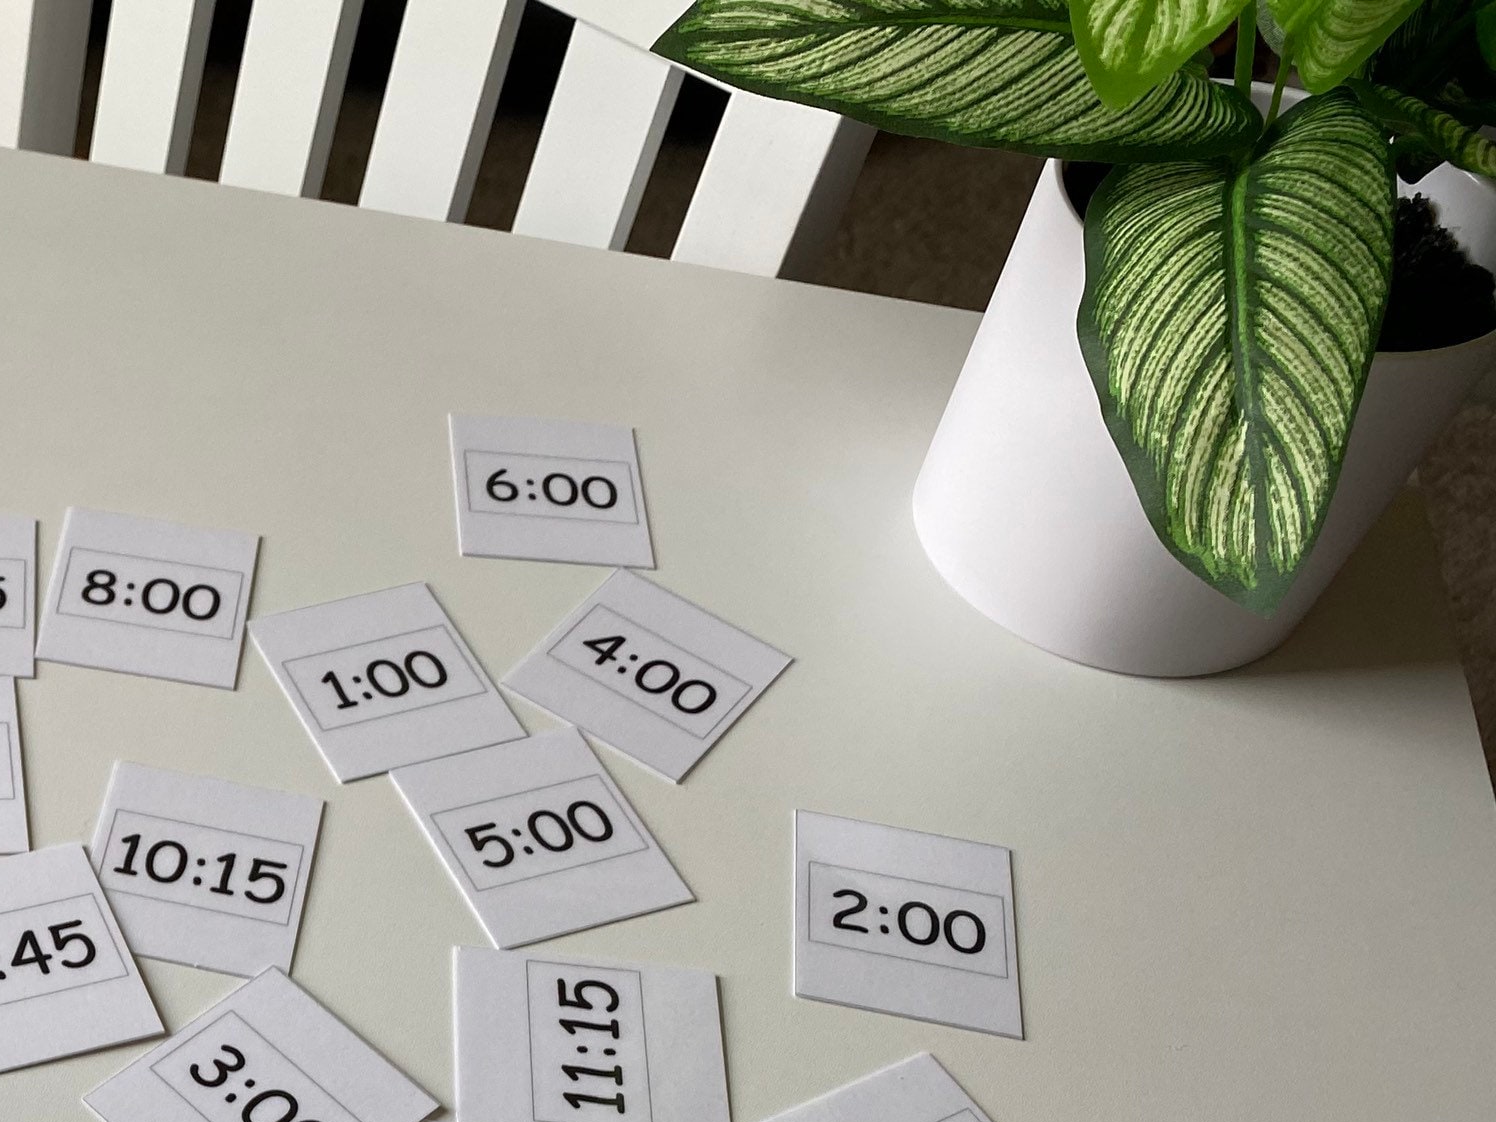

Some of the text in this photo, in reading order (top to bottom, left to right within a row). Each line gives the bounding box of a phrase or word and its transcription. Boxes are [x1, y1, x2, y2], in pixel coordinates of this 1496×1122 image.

[485, 468, 618, 510] 6:00
[81, 569, 221, 621] 8:00
[321, 650, 448, 710] 1:00
[582, 635, 718, 715] 4:00
[464, 800, 614, 869] 5:00
[113, 833, 288, 905] 10:15
[832, 888, 987, 955] 2:00
[556, 978, 626, 1115] 11:15
